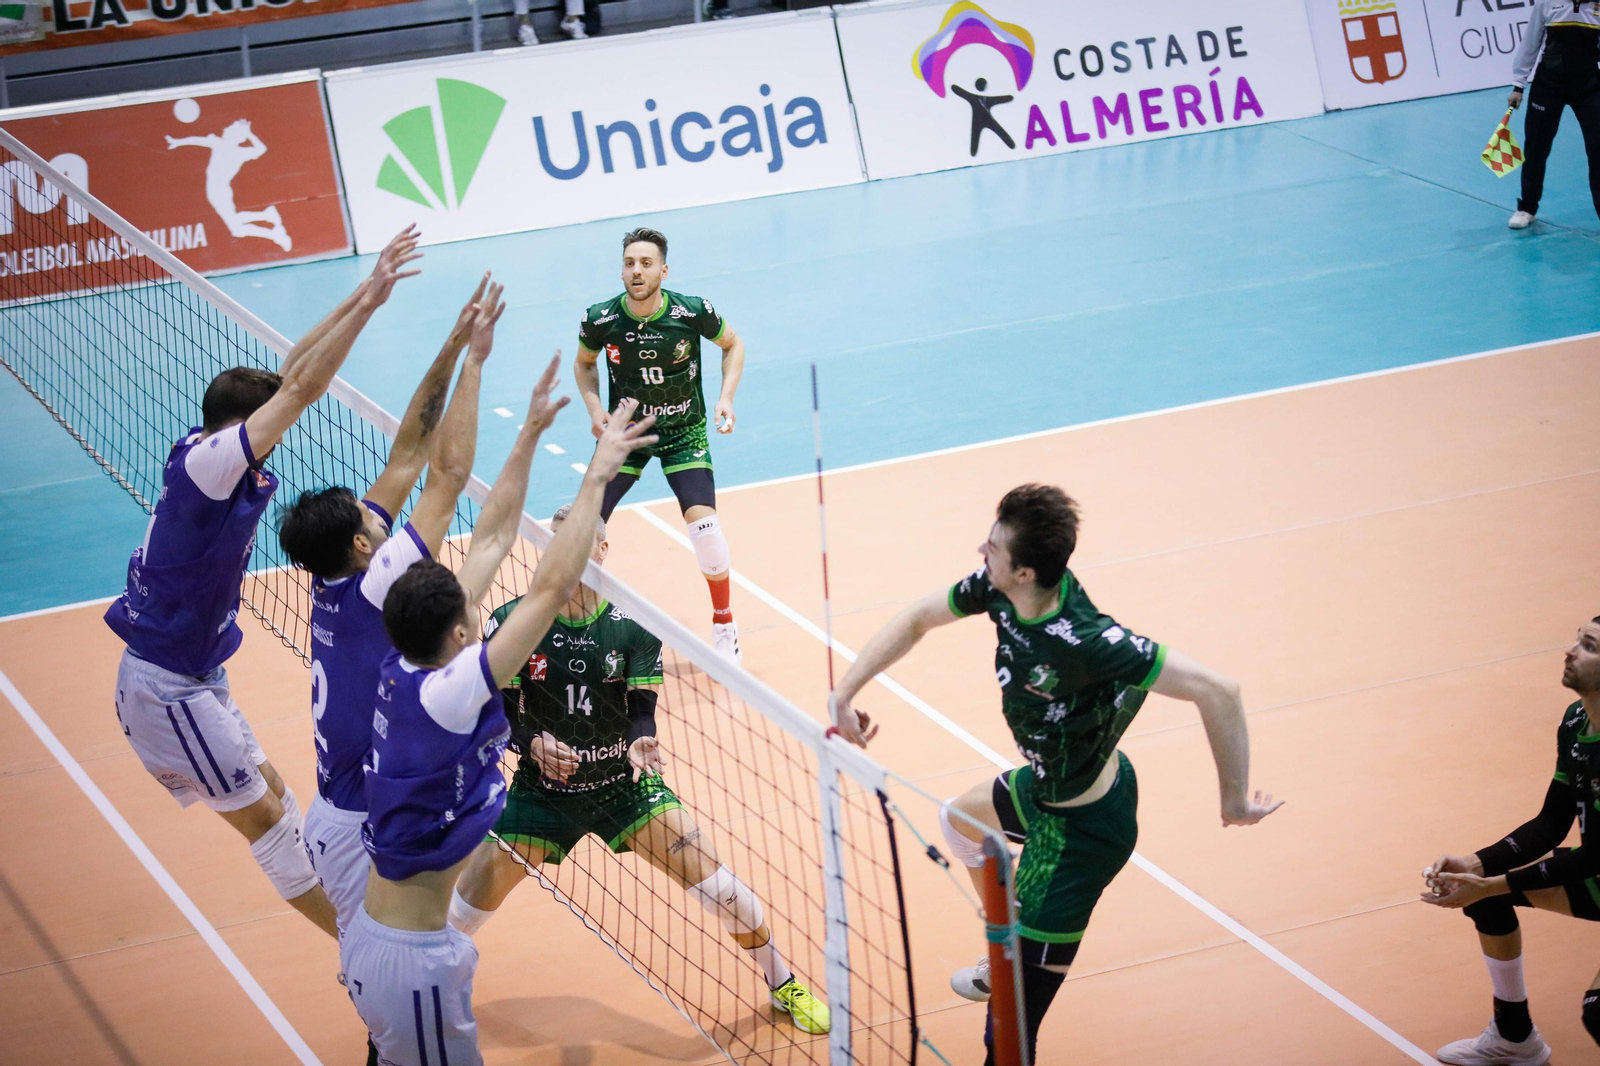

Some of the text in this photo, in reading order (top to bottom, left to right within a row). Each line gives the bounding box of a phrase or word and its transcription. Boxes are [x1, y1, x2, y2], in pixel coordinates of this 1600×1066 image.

[54, 0, 129, 32] LA
[1053, 25, 1248, 81] COSTA DE
[1024, 66, 1264, 150] ALMERÍA
[532, 83, 828, 180] Unicaja
[638, 366, 665, 385] 10
[564, 683, 593, 716] 14
